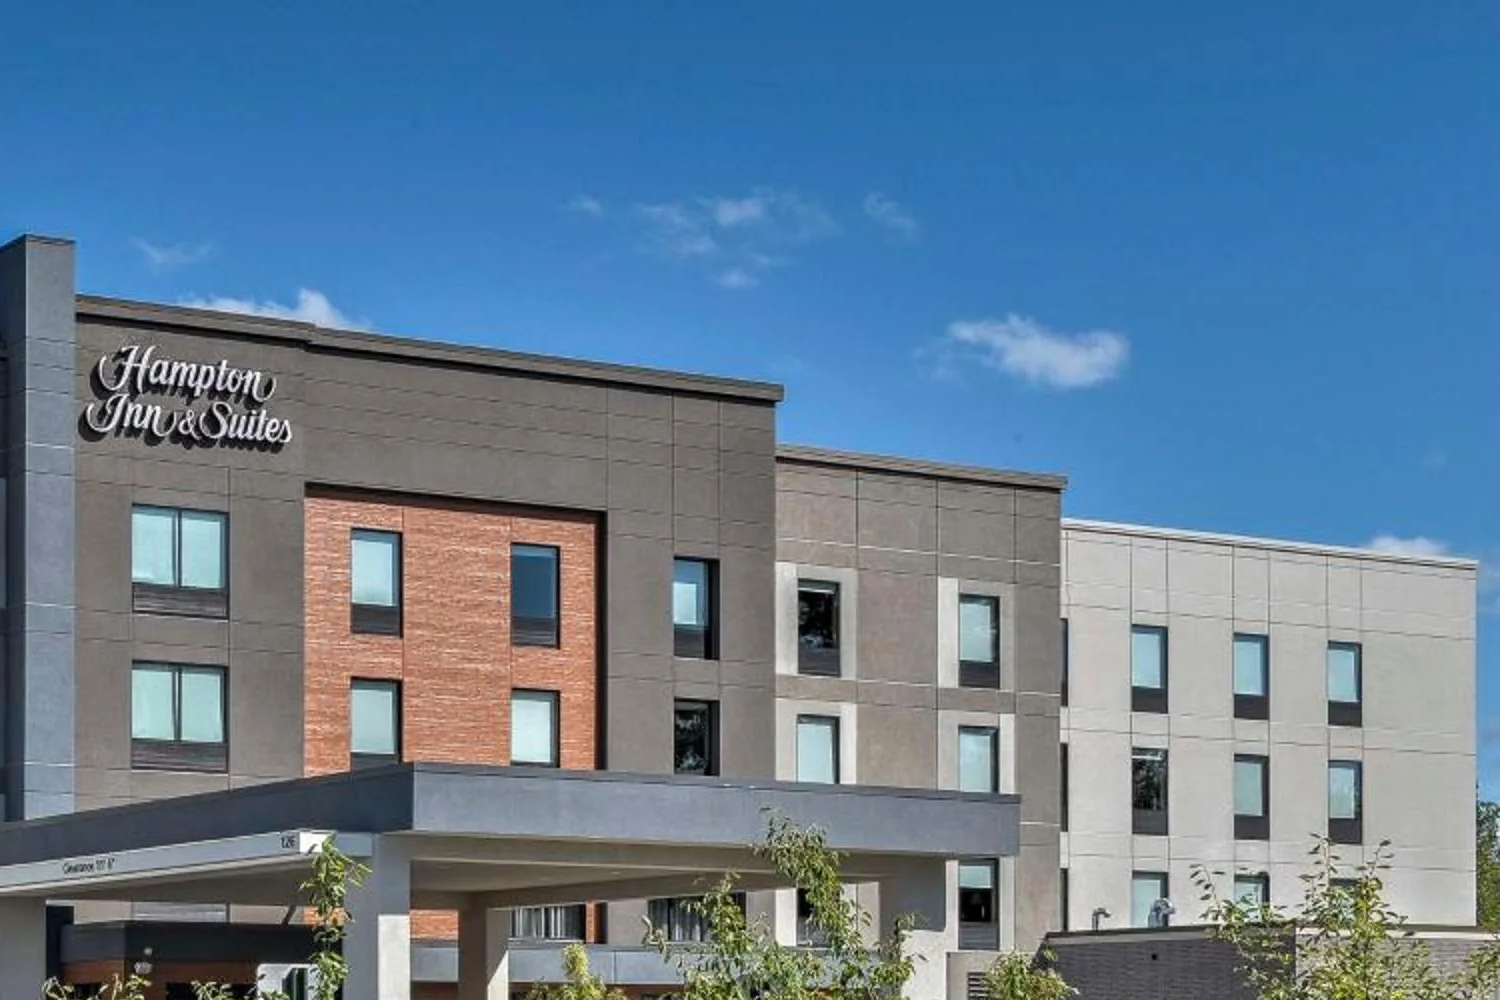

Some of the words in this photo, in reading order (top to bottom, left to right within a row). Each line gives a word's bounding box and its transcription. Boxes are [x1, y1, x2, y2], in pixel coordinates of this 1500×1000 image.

[99, 345, 277, 402] Hampton
[86, 393, 177, 437] Inn
[178, 409, 202, 441] &
[199, 401, 293, 443] Suites
